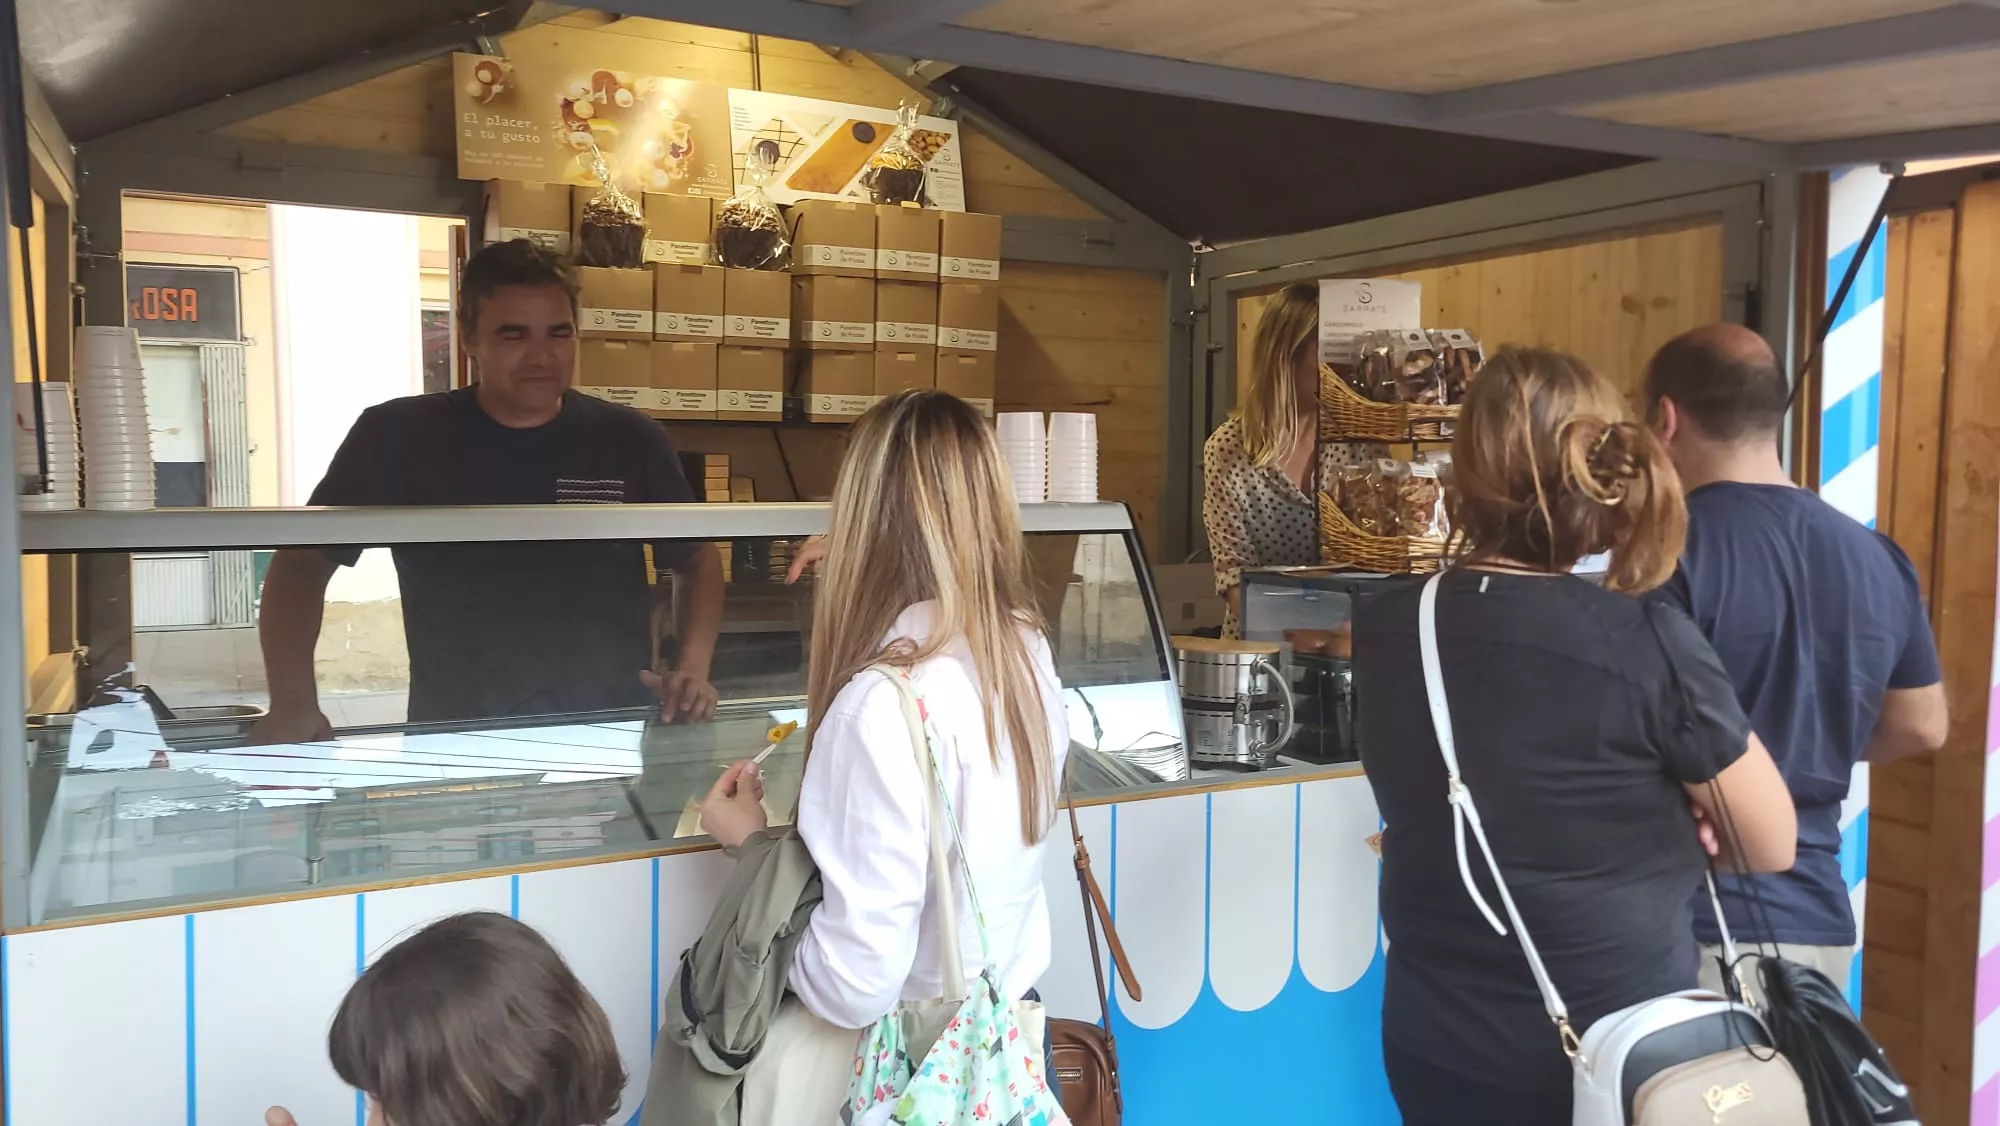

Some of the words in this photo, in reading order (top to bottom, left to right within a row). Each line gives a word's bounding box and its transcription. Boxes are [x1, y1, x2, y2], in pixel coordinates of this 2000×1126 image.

[464, 113, 479, 124] El
[486, 115, 538, 131] placer,
[464, 129, 472, 138] a
[480, 130, 496, 140] tu
[502, 133, 541, 144] gusto
